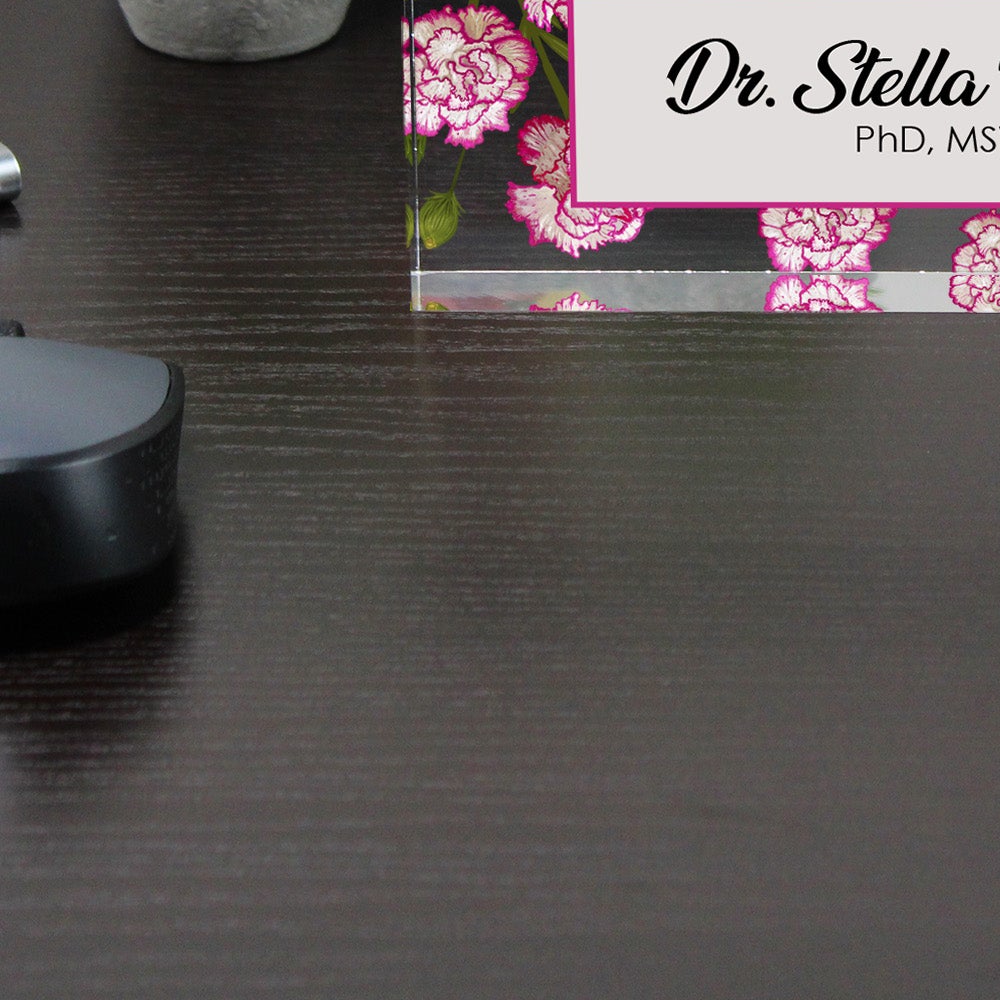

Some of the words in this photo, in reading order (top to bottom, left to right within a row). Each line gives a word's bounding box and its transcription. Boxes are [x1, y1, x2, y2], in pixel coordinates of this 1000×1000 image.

[665, 38, 776, 115] Dr.
[792, 38, 991, 115] Stella
[856, 124, 934, 156] PhD,
